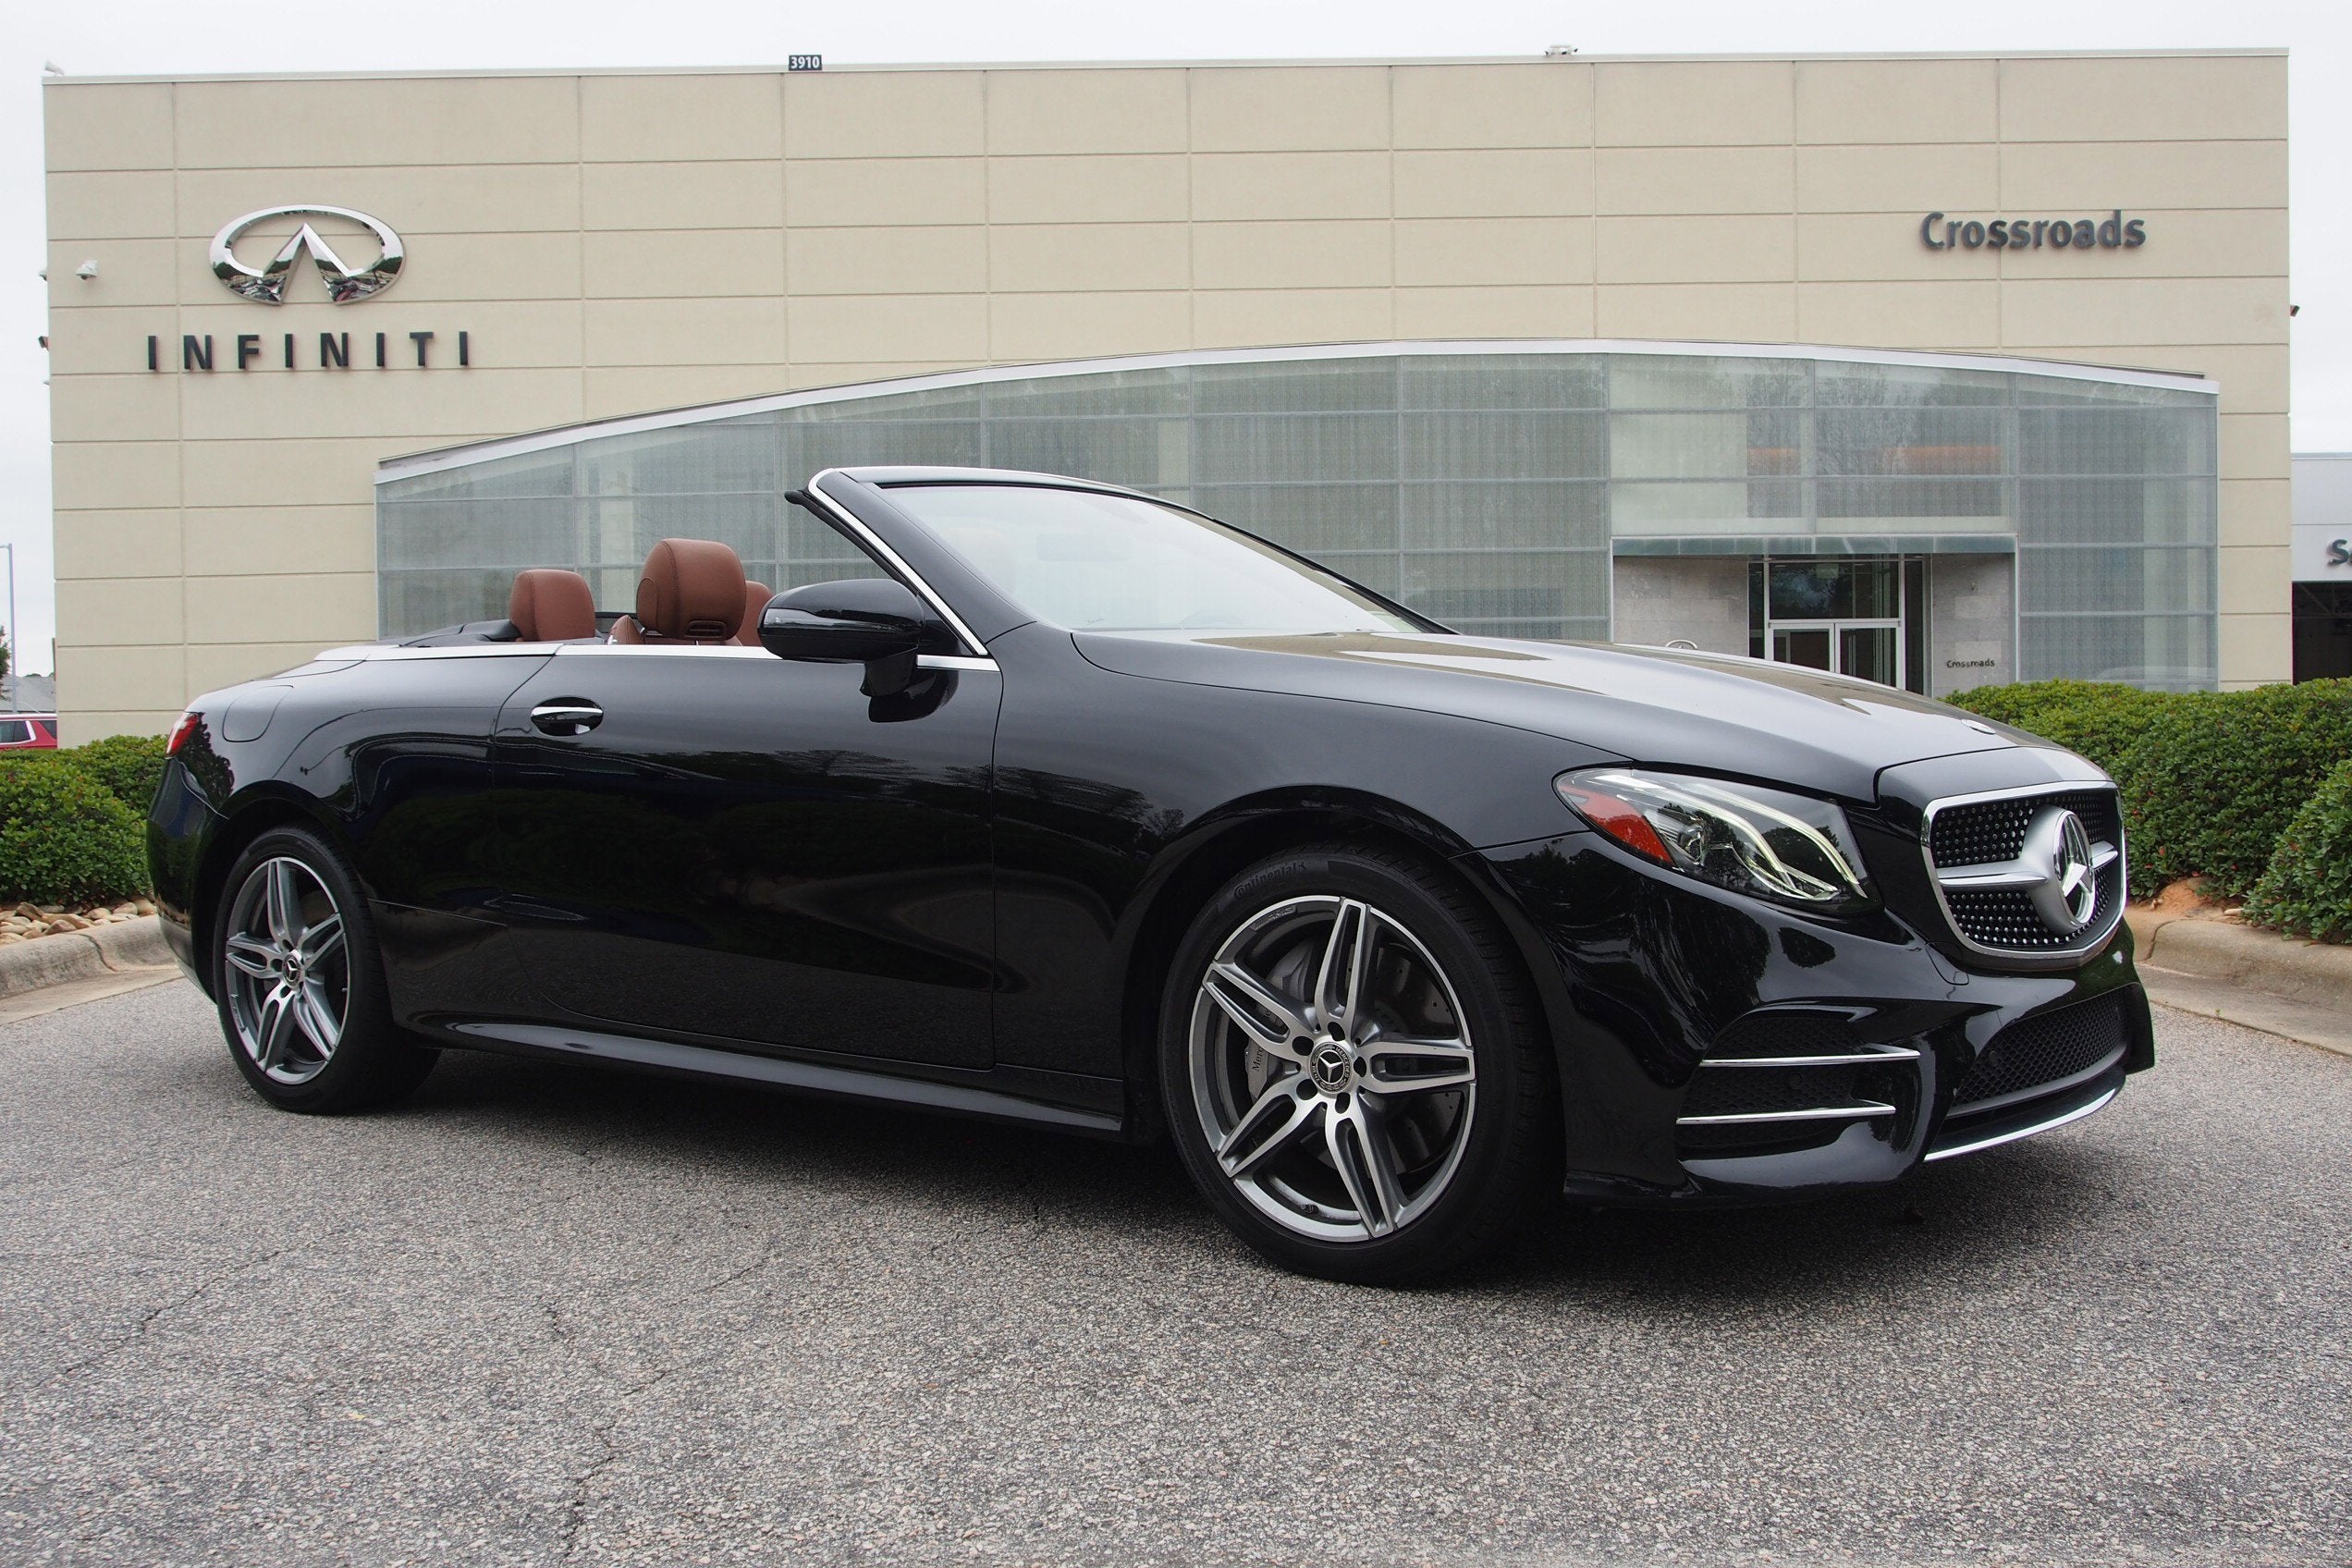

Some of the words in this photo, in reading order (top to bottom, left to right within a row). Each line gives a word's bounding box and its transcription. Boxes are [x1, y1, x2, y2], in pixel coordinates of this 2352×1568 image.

[790, 55, 820, 69] 3910
[1920, 209, 2147, 250] Crossroads
[147, 330, 469, 371] INFINITI
[2326, 538, 2352, 566] S
[1946, 658, 1995, 668] Crossroads
